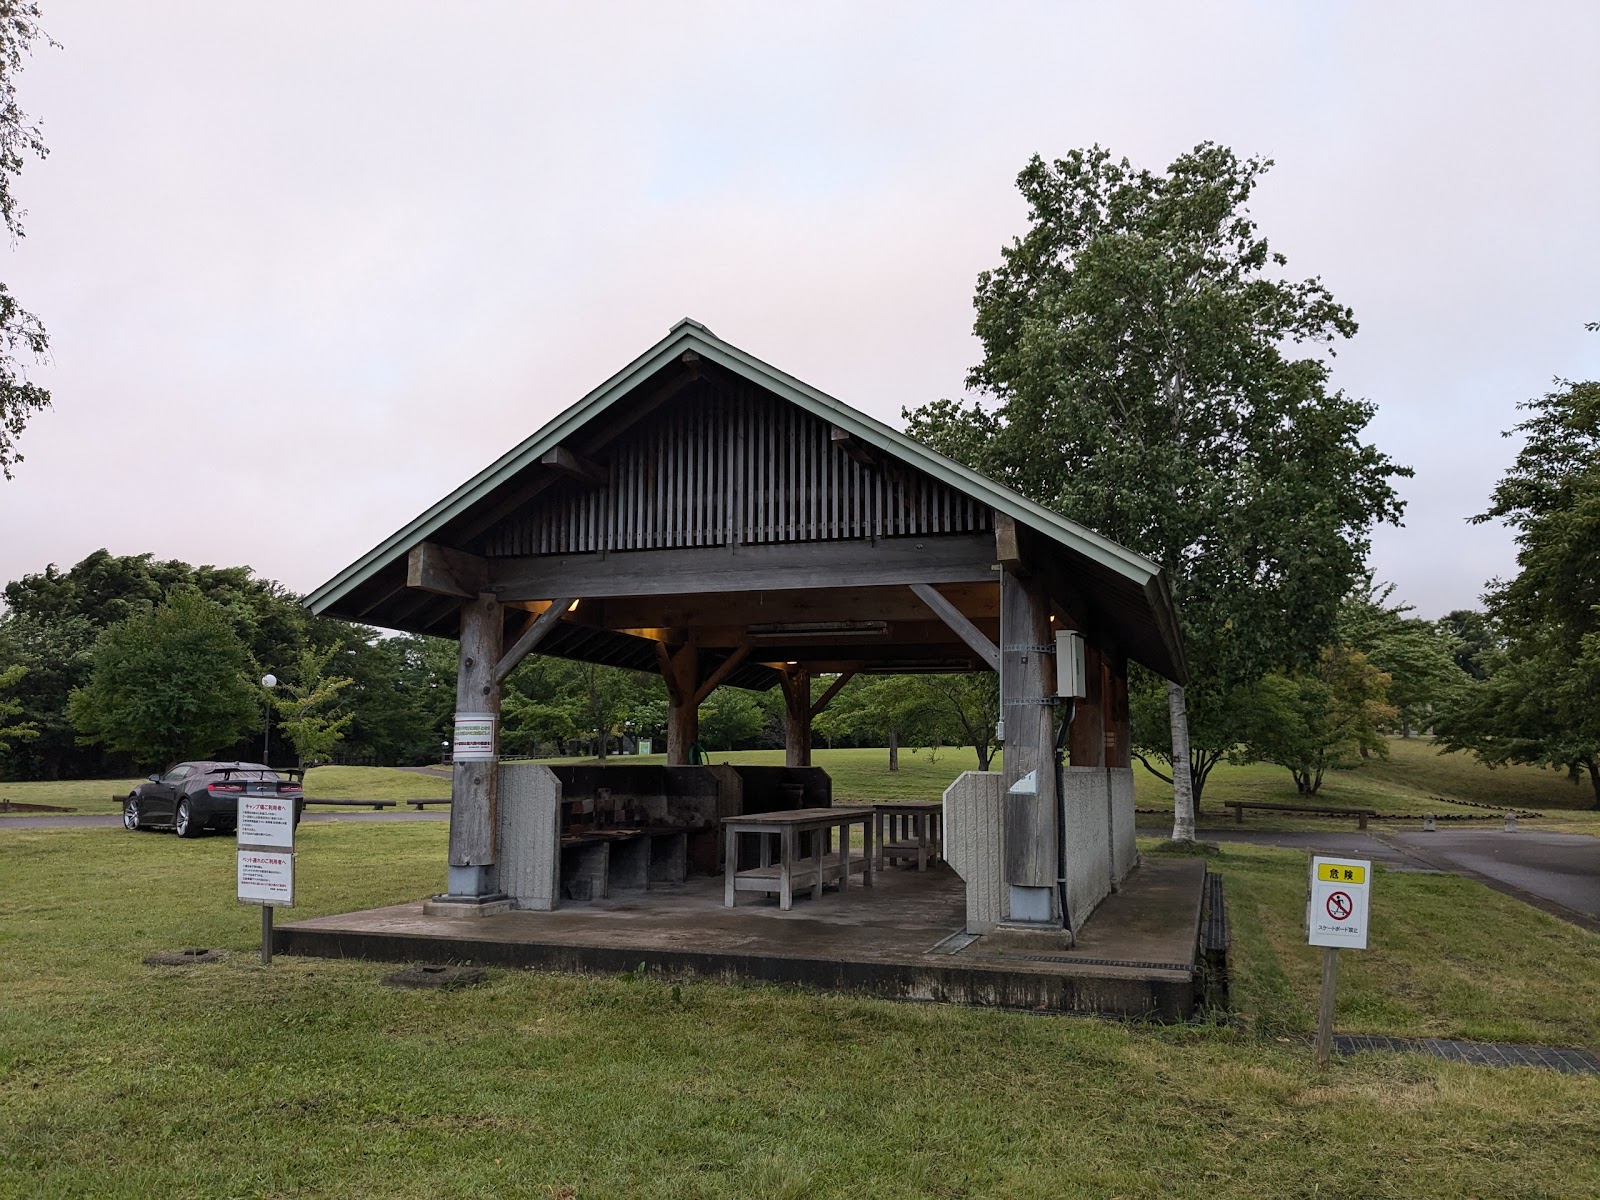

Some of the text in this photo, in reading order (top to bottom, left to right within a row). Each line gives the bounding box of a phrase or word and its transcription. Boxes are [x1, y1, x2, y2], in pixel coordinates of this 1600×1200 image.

[1329, 868, 1354, 880] 危険
[1318, 925, 1359, 934] スケートボード禁止
